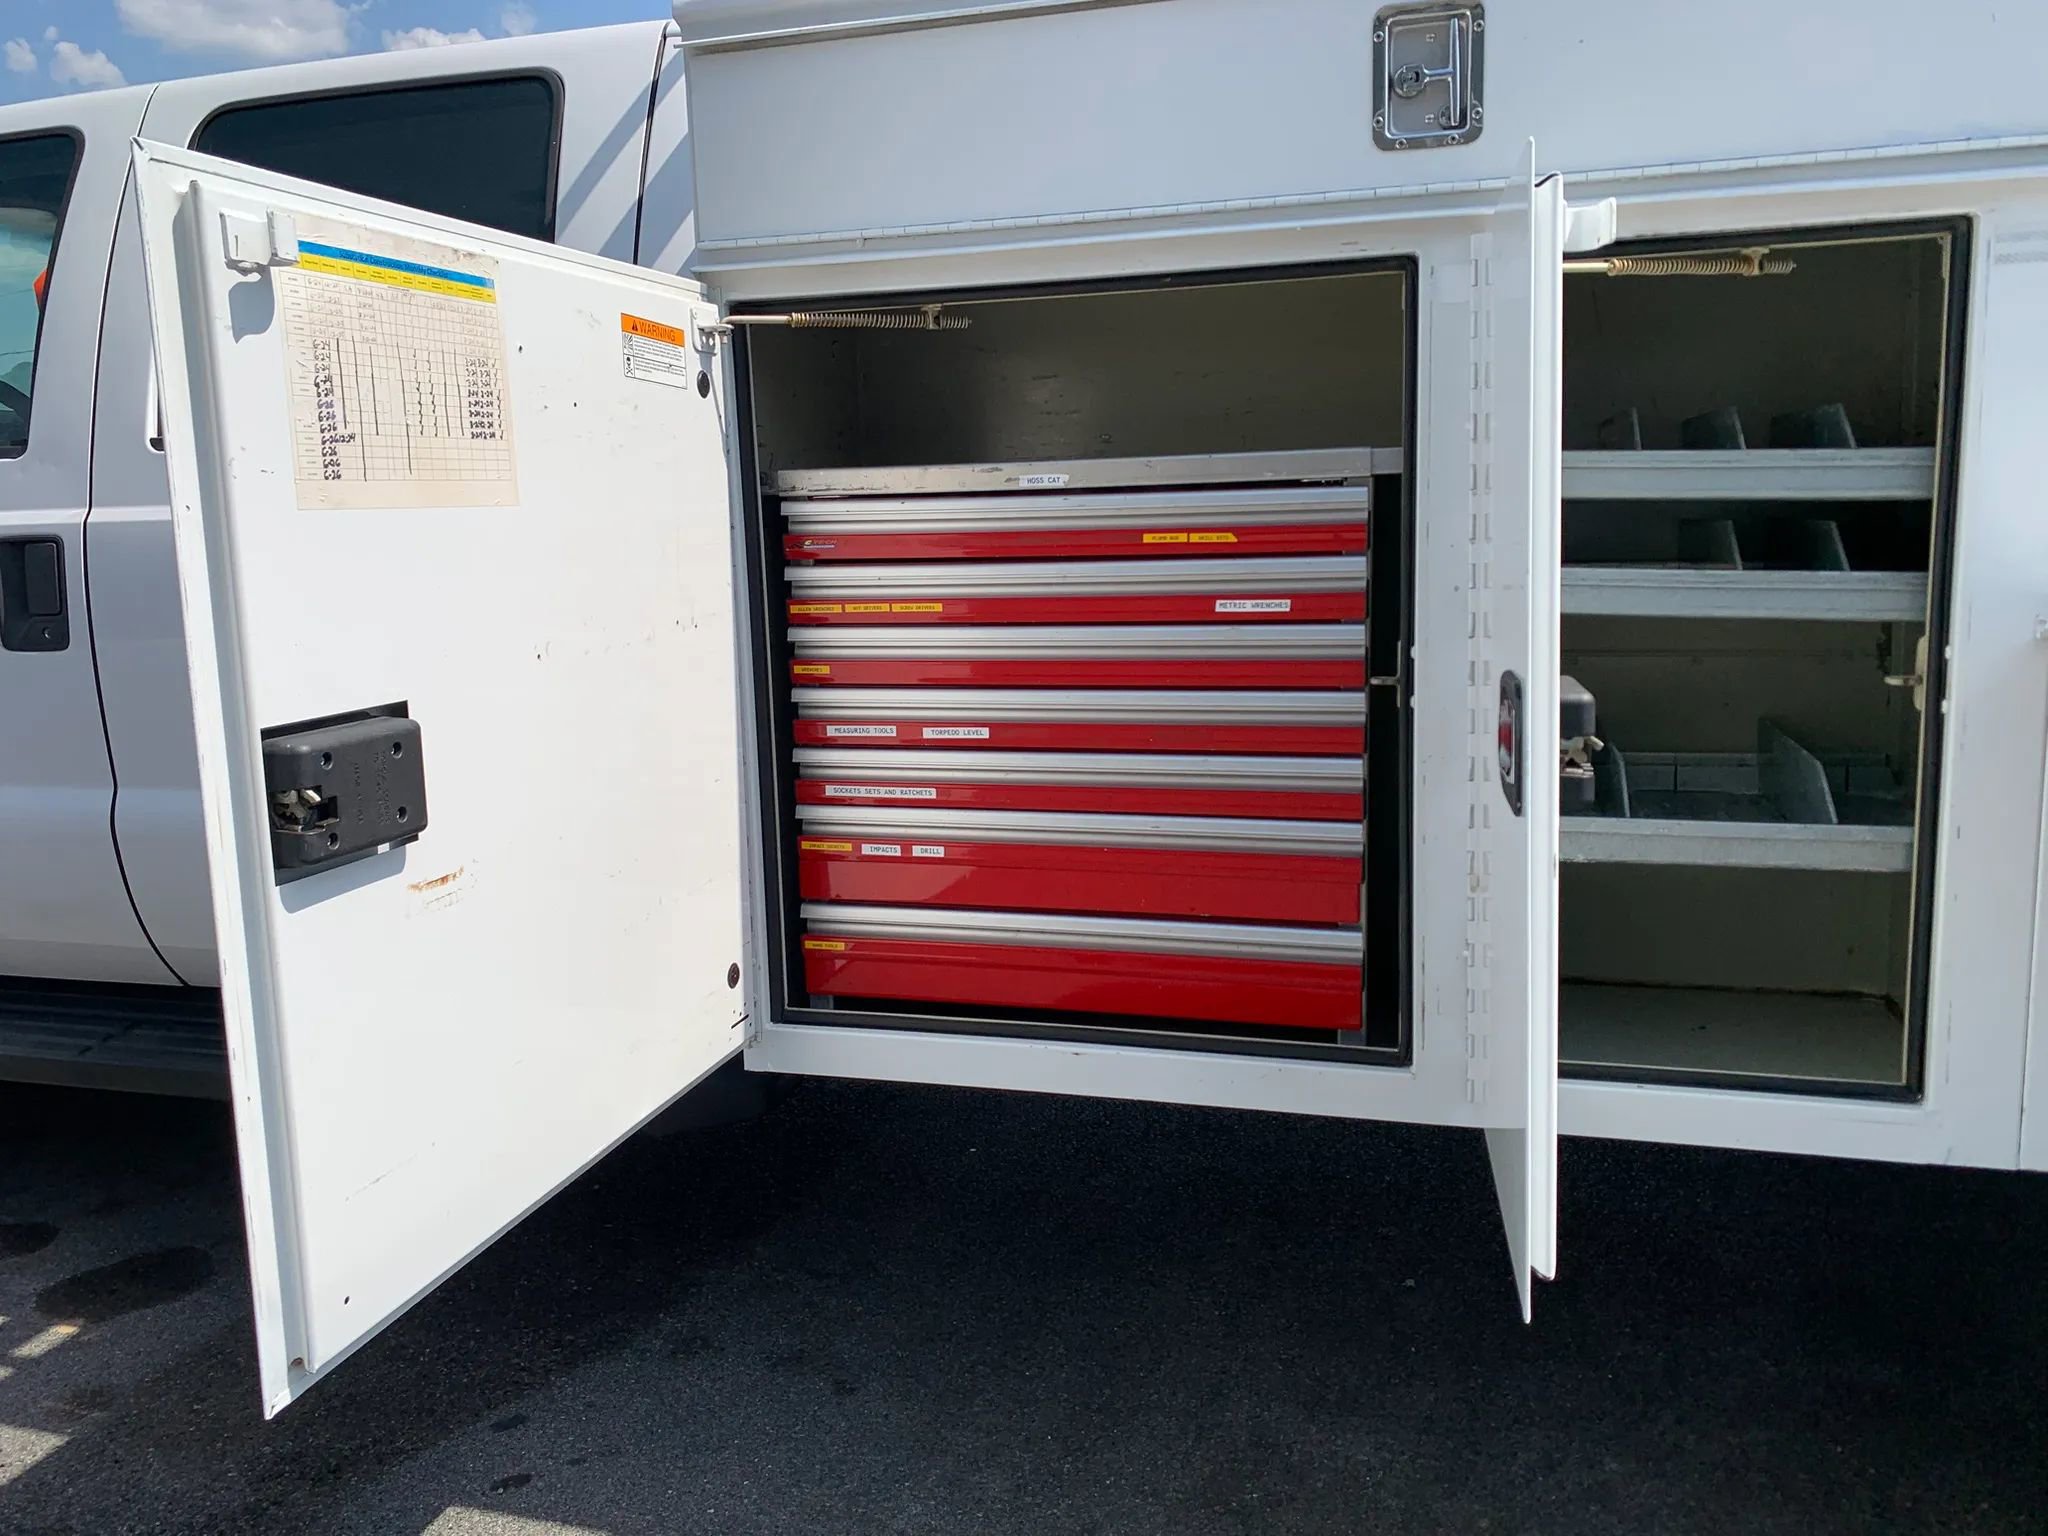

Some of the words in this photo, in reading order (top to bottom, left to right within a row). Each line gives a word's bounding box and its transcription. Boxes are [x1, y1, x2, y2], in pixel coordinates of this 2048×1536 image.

[639, 320, 676, 342] WARNING
[1026, 476, 1045, 485] HOSS
[1047, 476, 1061, 484] CAT
[834, 727, 870, 735] MEASURING
[884, 788, 897, 796] AND
[900, 788, 933, 796] RATCHETS
[869, 846, 898, 854] IMPACTS
[920, 847, 941, 855] DRILL
